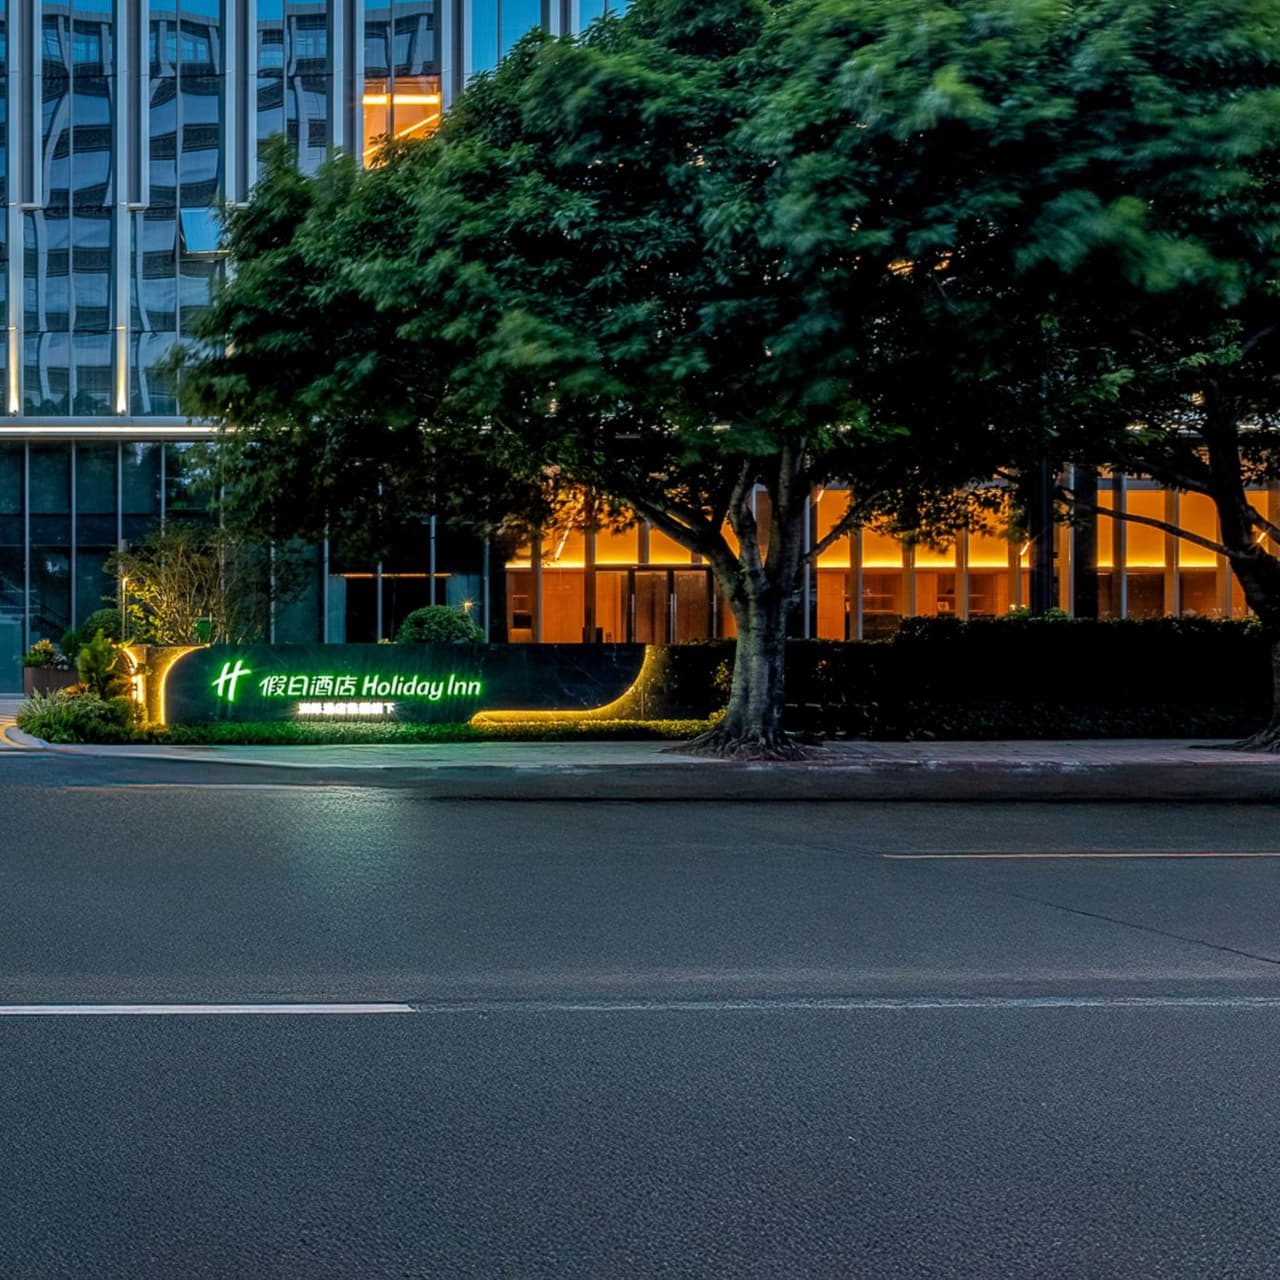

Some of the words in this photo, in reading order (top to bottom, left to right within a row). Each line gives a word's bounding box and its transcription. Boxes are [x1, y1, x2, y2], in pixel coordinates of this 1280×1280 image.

[259, 675, 359, 697] 假日酒店
[362, 675, 444, 701] Holiday
[446, 674, 481, 696] Inn
